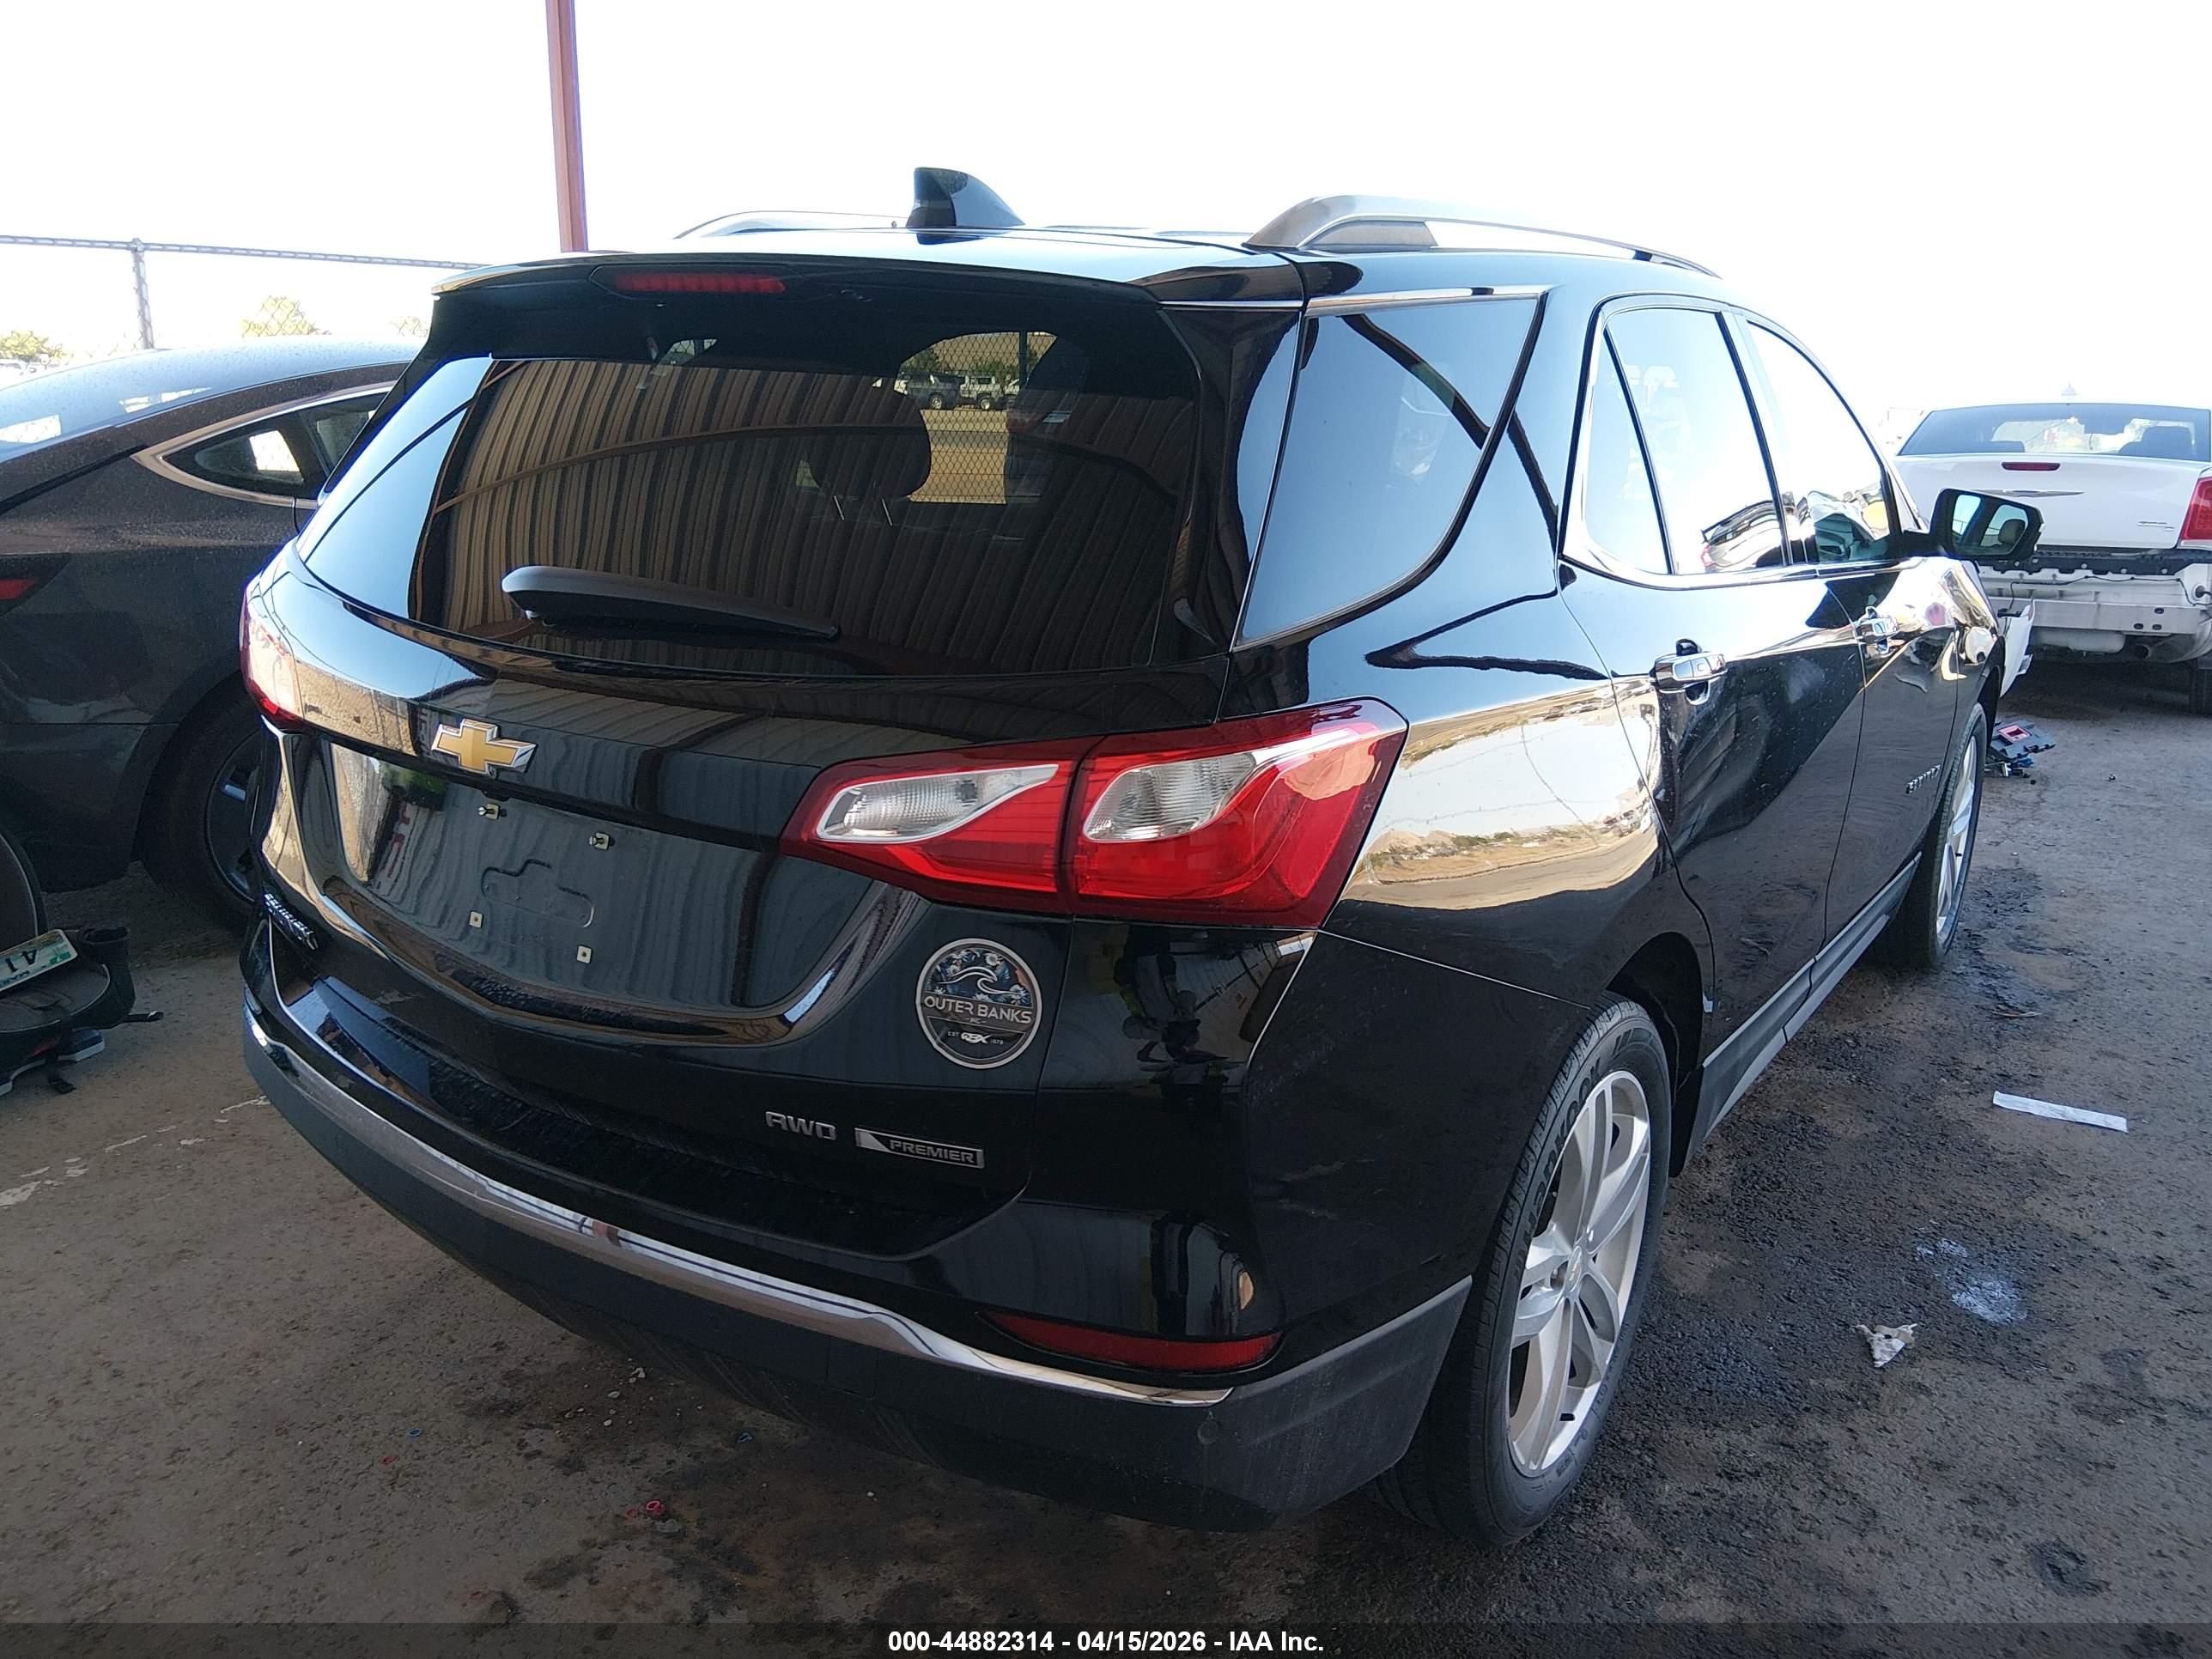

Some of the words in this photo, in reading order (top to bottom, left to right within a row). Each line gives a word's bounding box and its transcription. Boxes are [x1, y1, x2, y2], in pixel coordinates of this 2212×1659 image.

[924, 995, 974, 1016] OUTER
[977, 1005, 1032, 1024] BANKS
[765, 1111, 836, 1140] AWD
[889, 1139, 975, 1163] PREMIER
